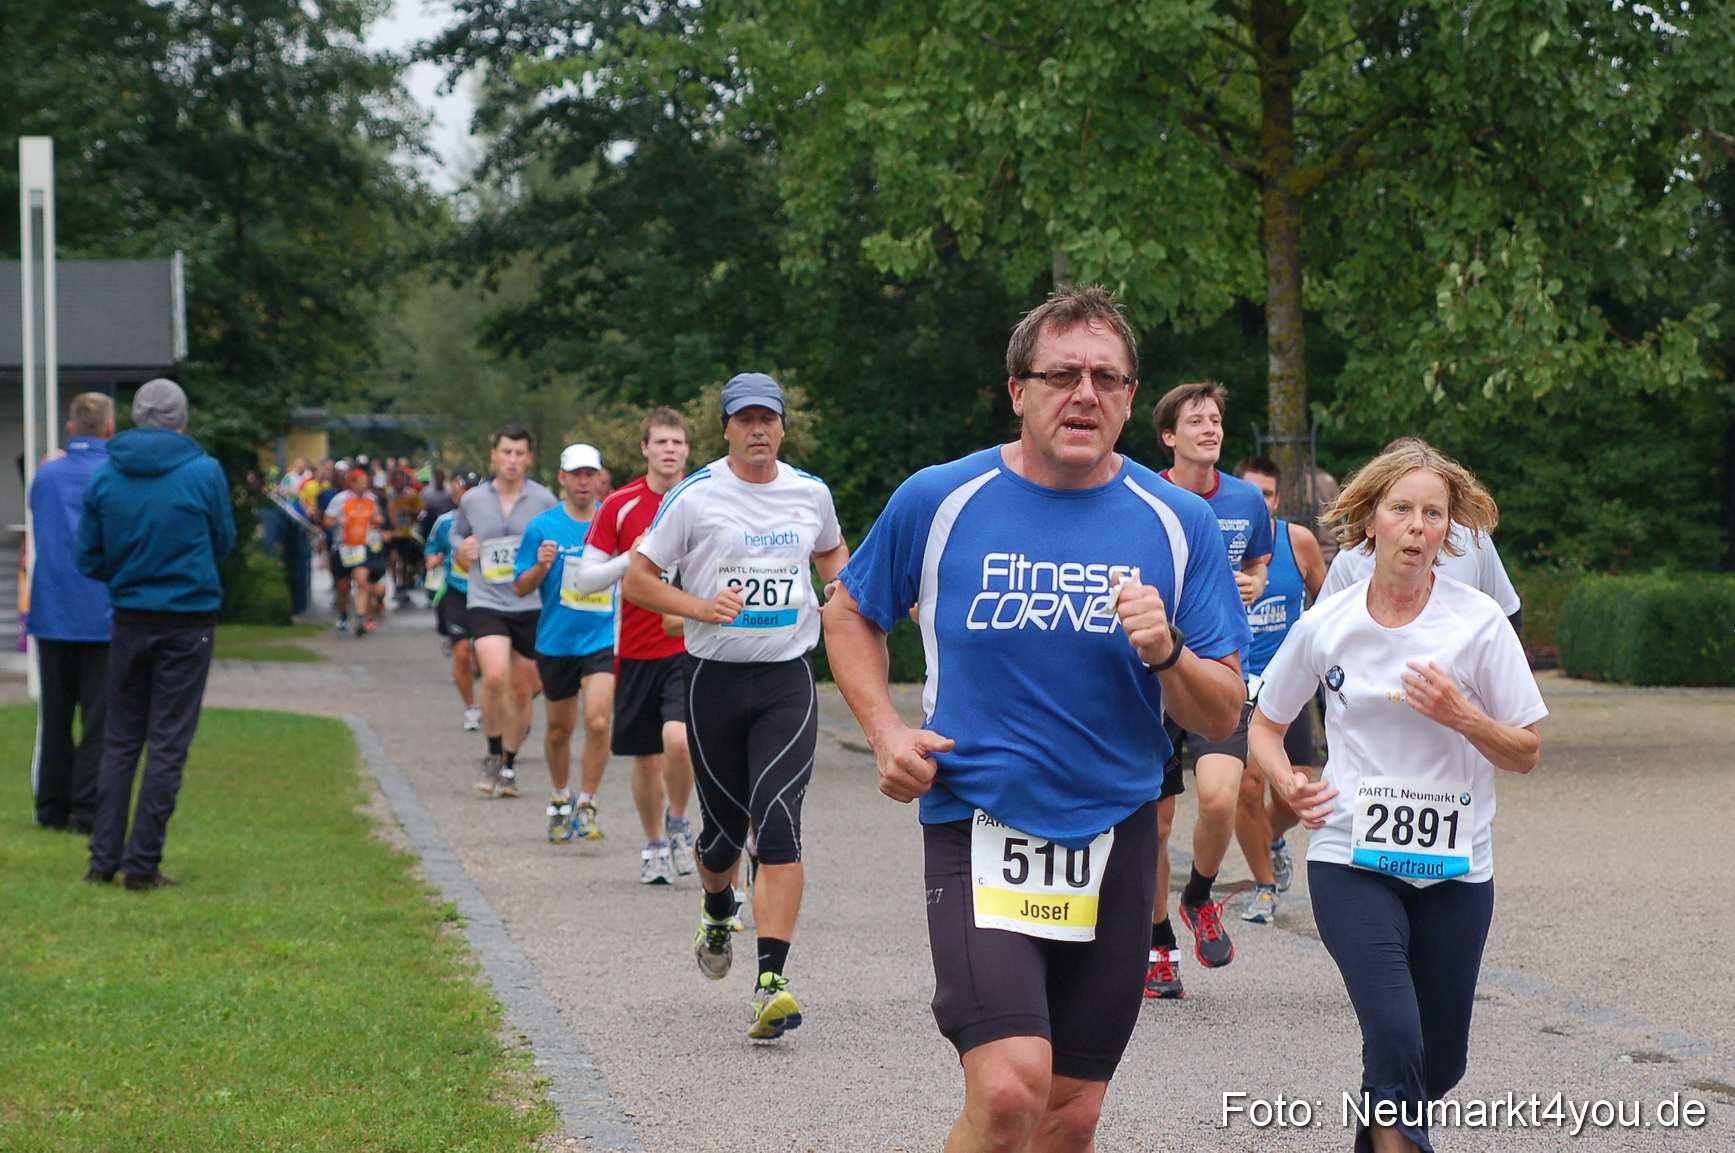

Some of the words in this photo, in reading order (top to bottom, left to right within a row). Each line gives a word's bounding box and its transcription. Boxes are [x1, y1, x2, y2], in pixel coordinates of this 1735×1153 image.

[744, 530, 799, 547] heinloth
[718, 566, 748, 575] PARTL
[749, 566, 787, 575] Neumarkt
[742, 613, 779, 625] Robert
[1358, 787, 1397, 798] PARTL
[1400, 788, 1456, 803] Neumarkt
[1365, 803, 1459, 849] 2891
[1003, 837, 1091, 888] 510
[1378, 855, 1444, 876] Gertraud
[1020, 900, 1070, 921] Josef
